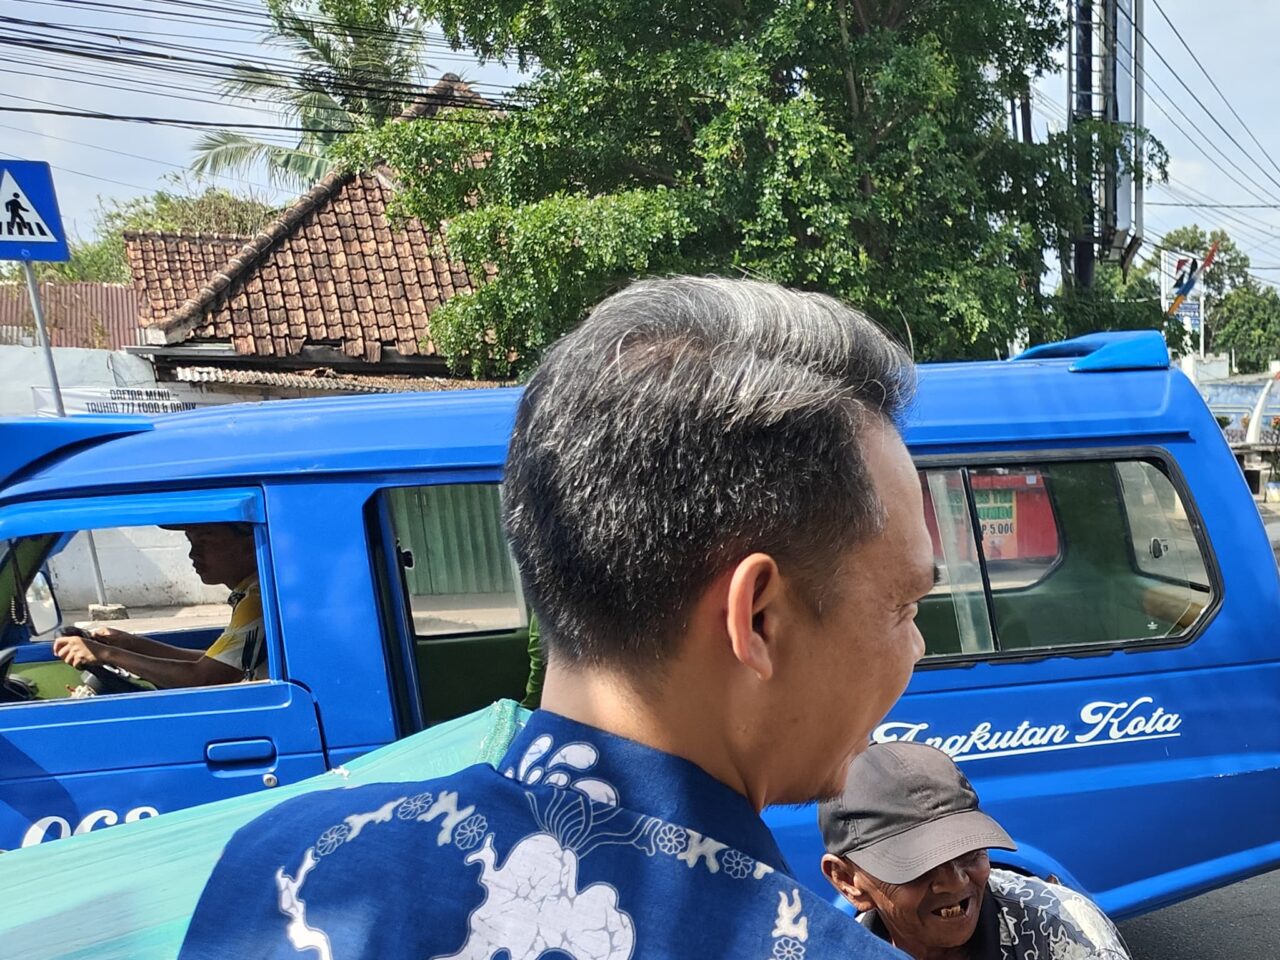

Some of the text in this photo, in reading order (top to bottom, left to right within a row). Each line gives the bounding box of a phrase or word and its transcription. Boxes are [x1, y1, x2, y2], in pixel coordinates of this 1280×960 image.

[110, 389, 171, 401] DAFTAR MENU
[138, 402, 160, 414] FOOD
[1075, 697, 1182, 742] Kota
